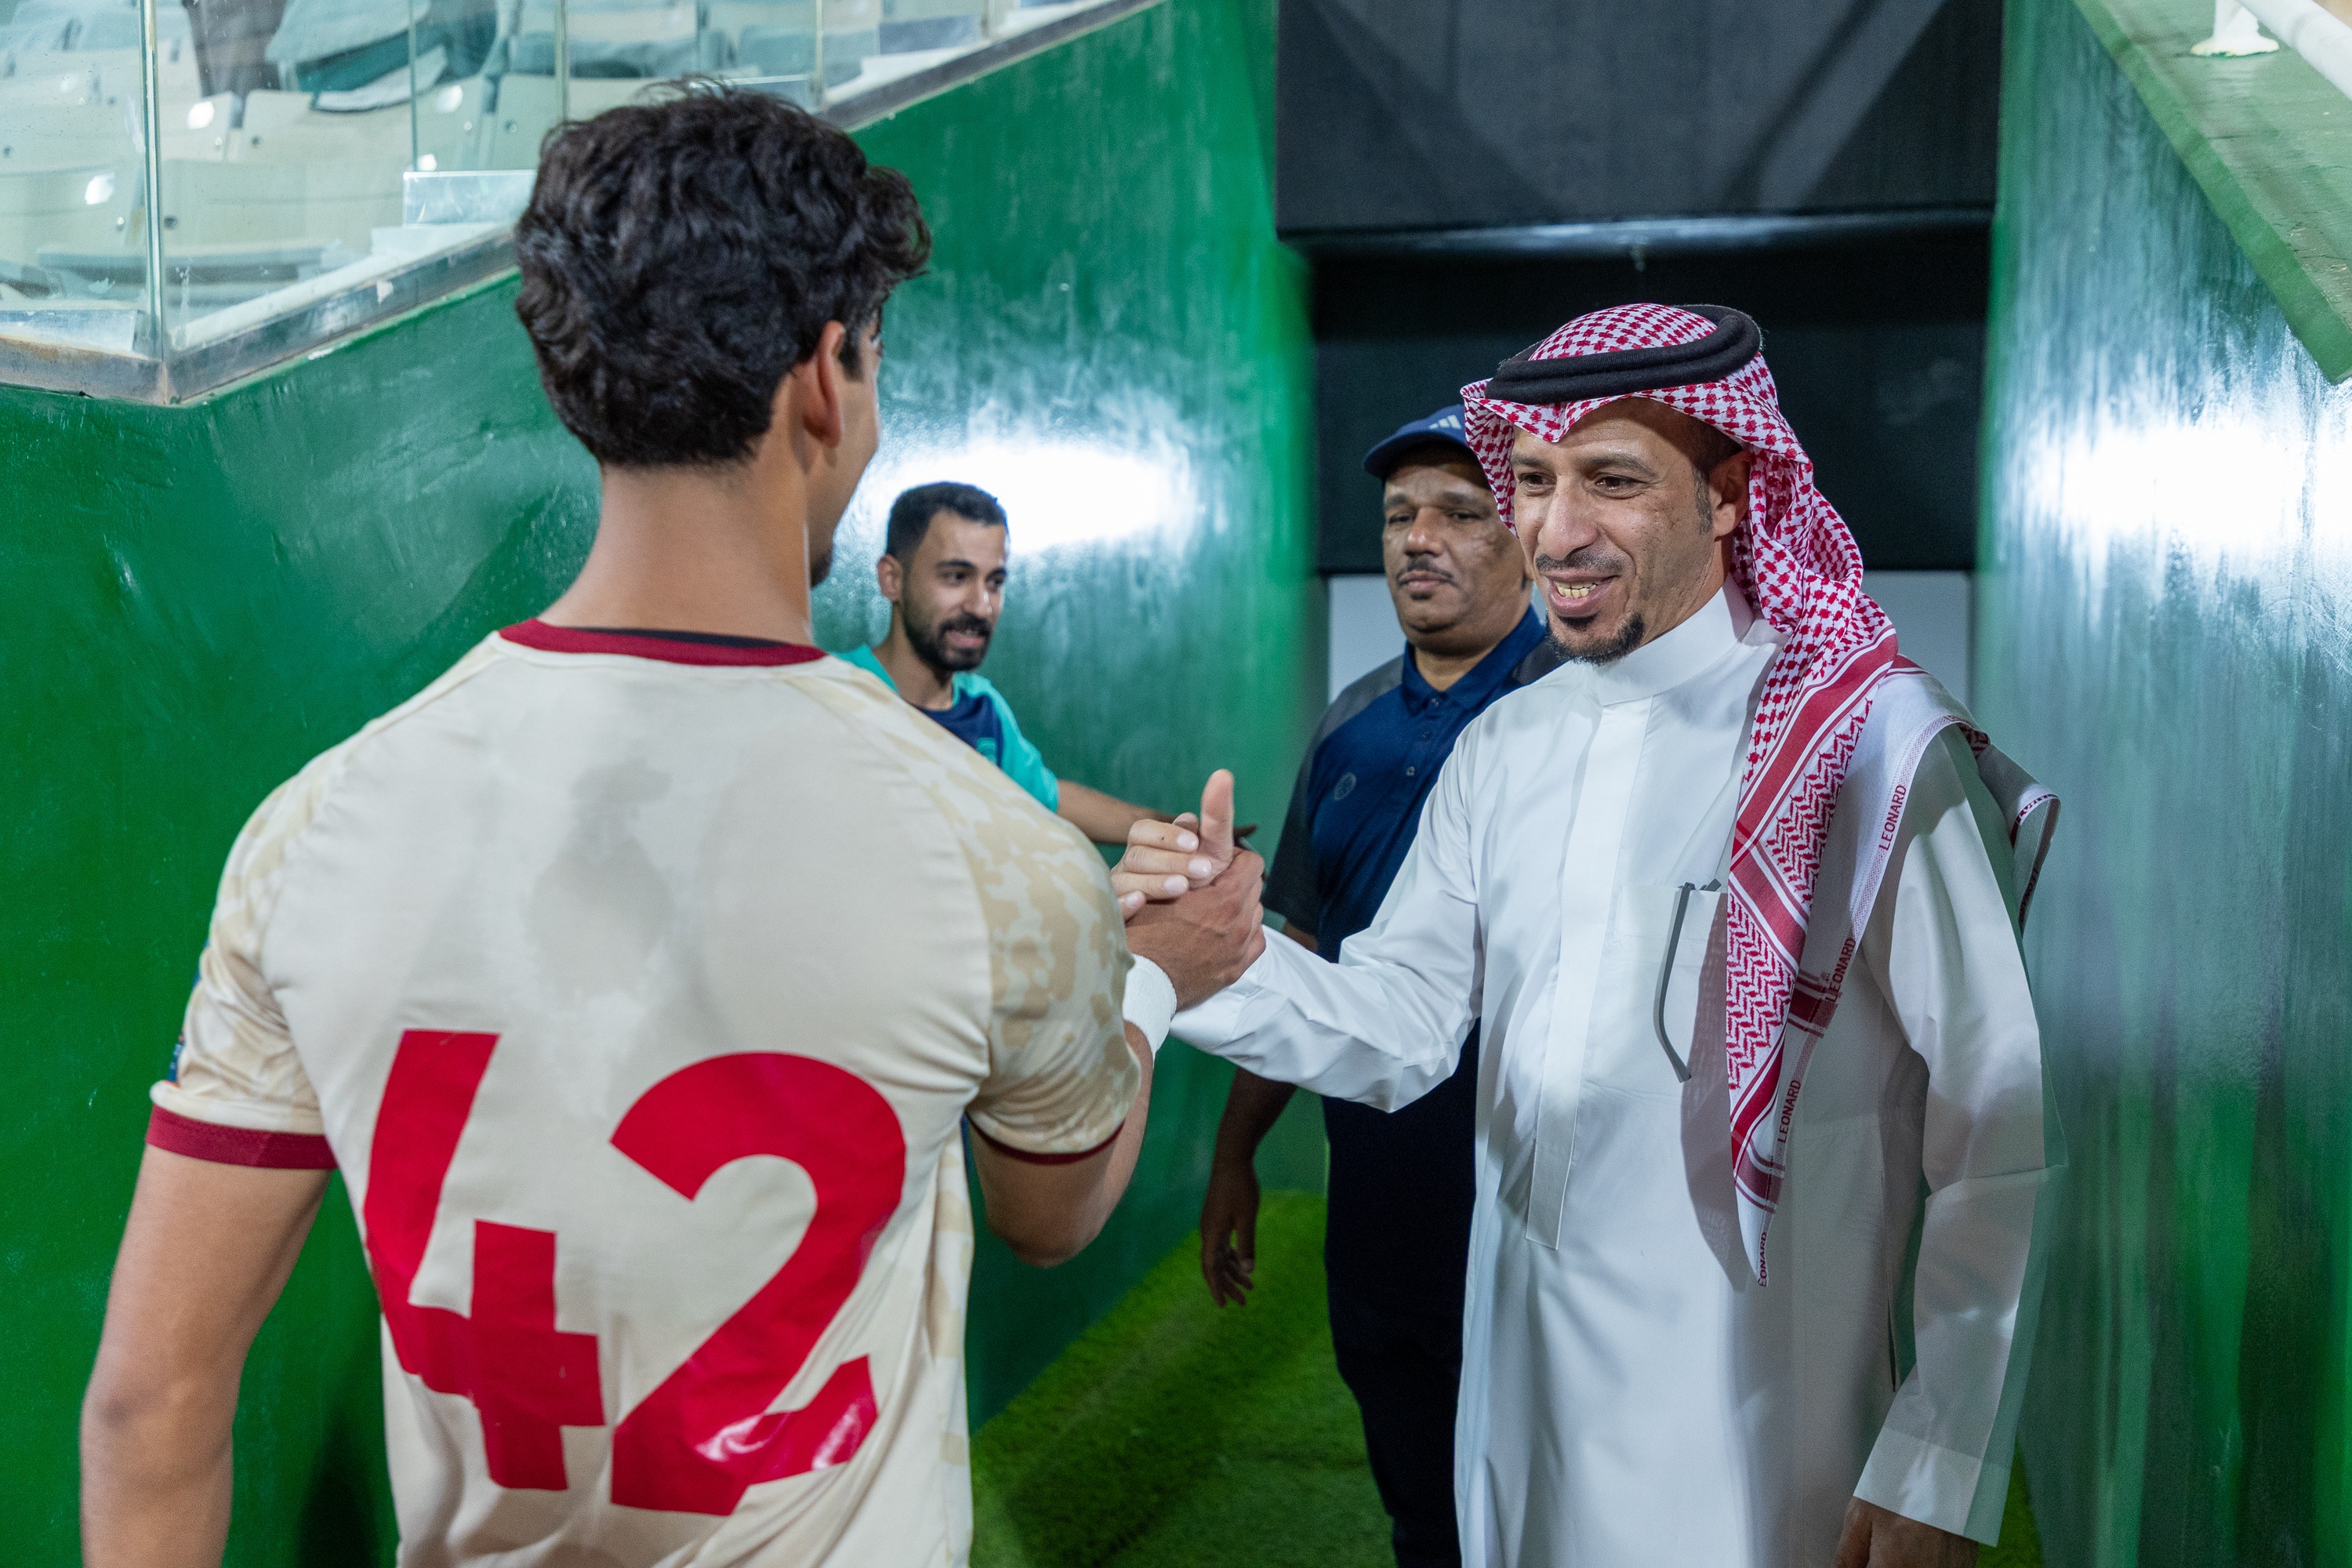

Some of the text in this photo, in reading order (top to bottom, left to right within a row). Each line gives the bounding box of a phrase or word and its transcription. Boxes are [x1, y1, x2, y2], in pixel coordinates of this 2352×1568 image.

[1878, 785, 1907, 851] LEONARD
[1825, 937, 1857, 1003] LEONARD
[1777, 1080, 1802, 1143] LEONARD
[363, 1029, 906, 1517] 42
[1758, 1232, 1767, 1287] EONARD
